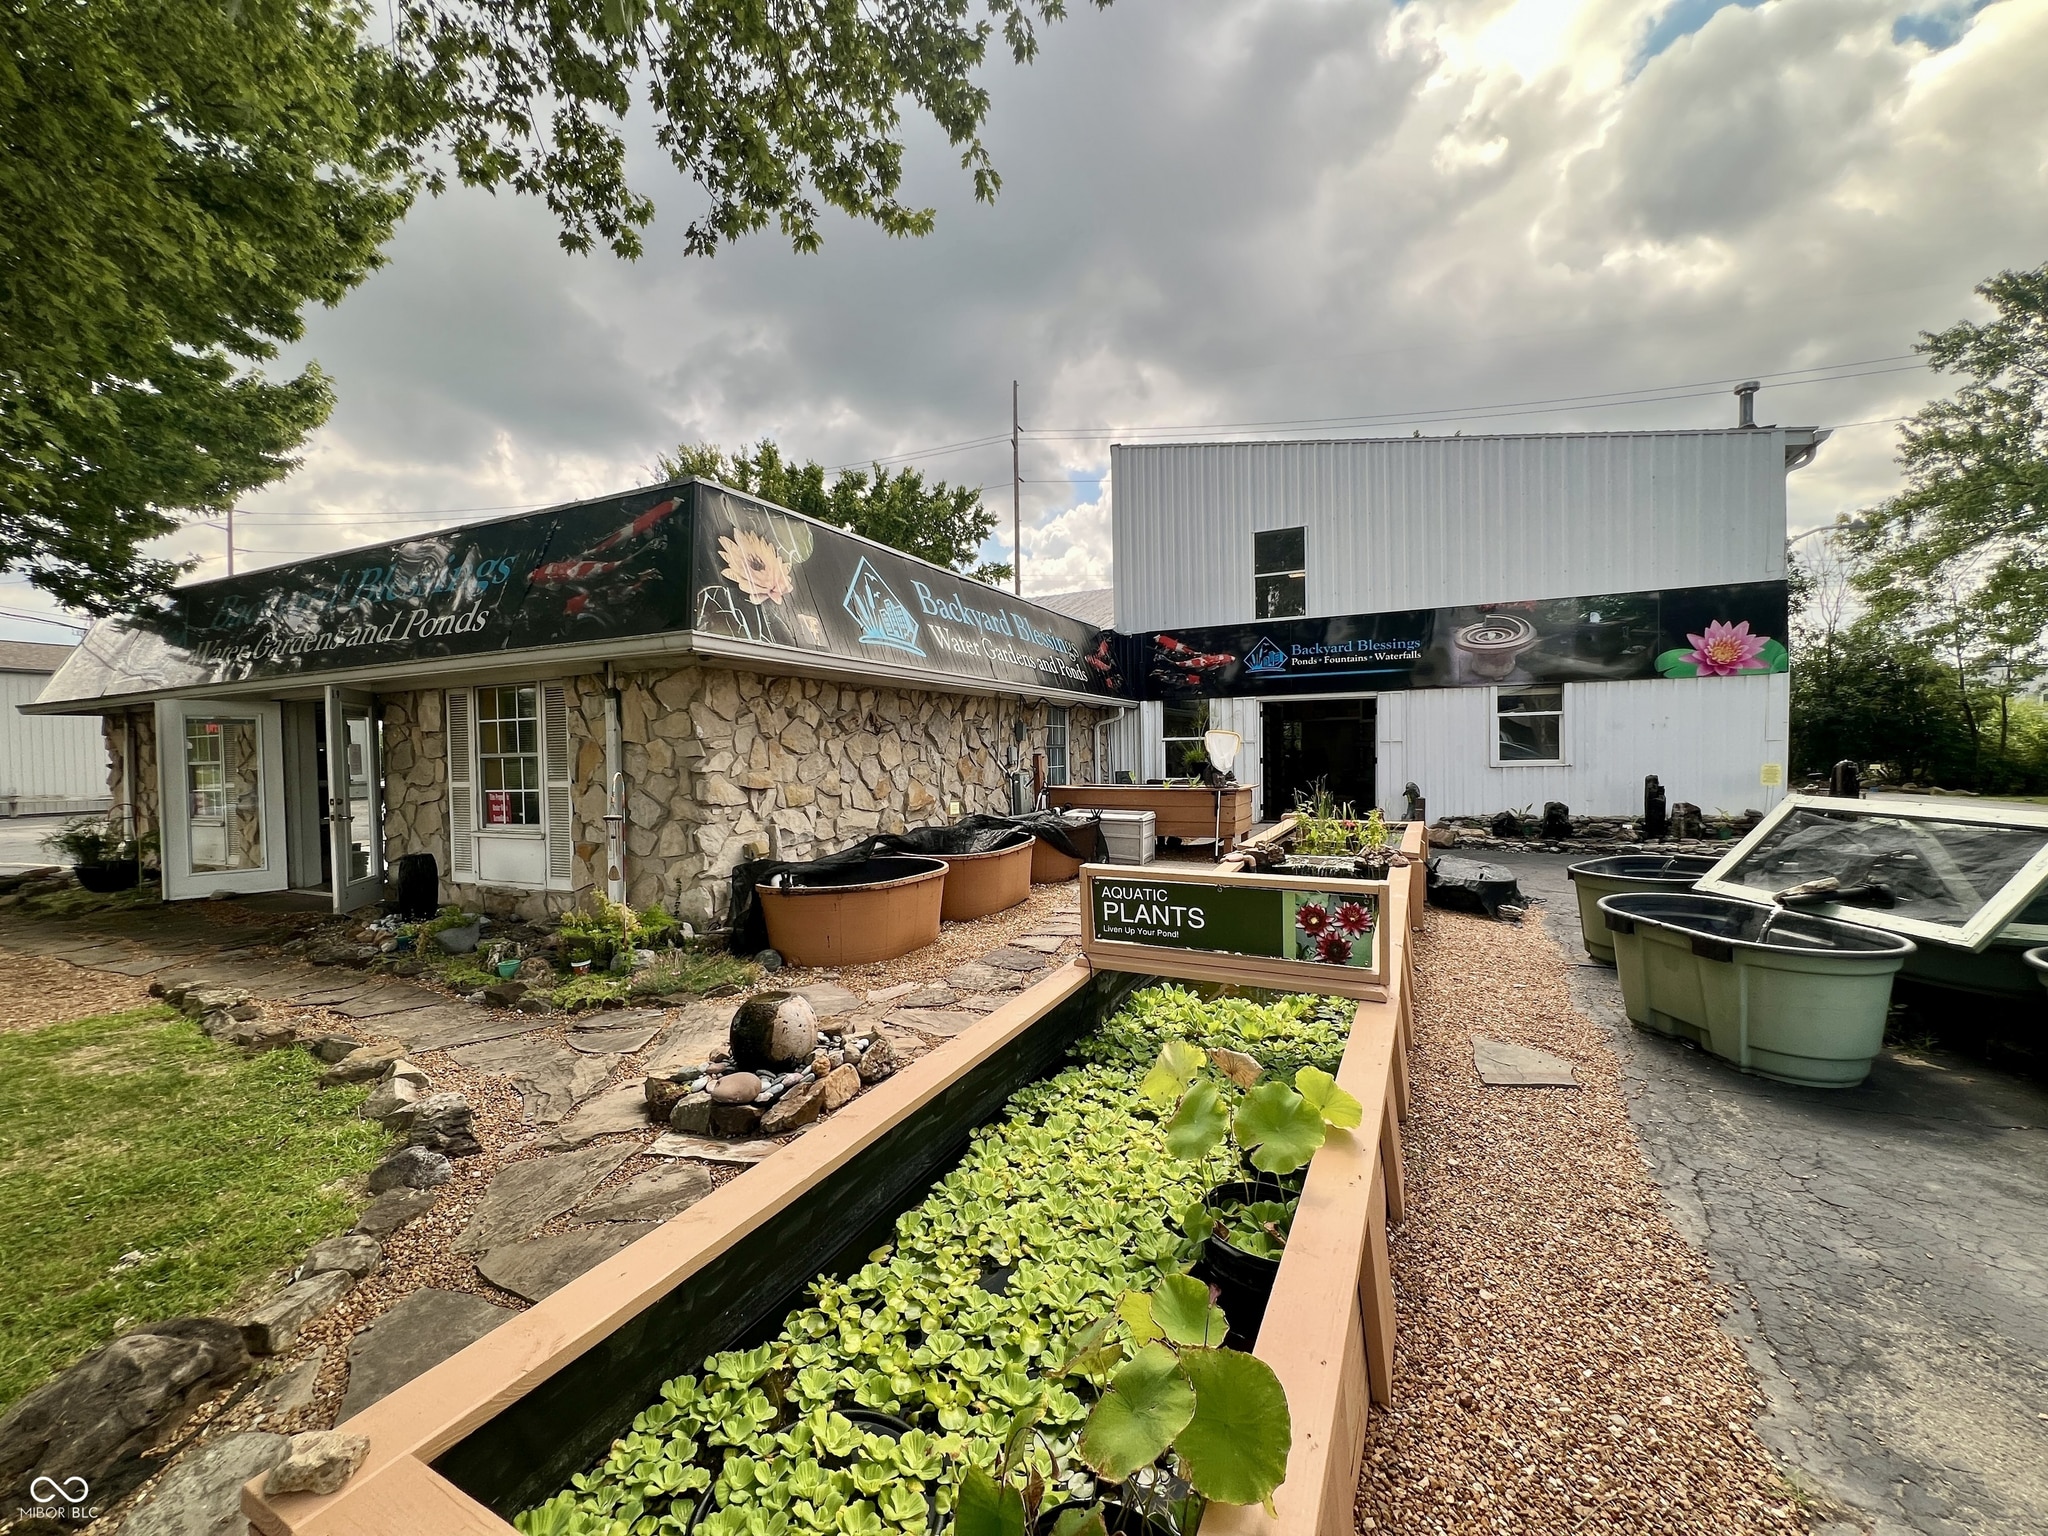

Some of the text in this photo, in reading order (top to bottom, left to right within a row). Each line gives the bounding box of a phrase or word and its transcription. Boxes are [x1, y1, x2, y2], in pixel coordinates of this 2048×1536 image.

[252, 625, 344, 660] Gardens
[346, 610, 402, 648] and
[399, 599, 490, 641] Ponds
[910, 579, 1080, 662] Backyard Blessings
[927, 623, 1089, 682] Water Gardens and Ponds
[1291, 638, 1421, 656] Backyard Blessings
[1291, 650, 1422, 666] Ponds Fountains Waterfalls
[1101, 886, 1168, 902] AQUATIC
[1103, 901, 1206, 929] PLANTS
[1103, 925, 1180, 938] Liven Up Your Pond!
